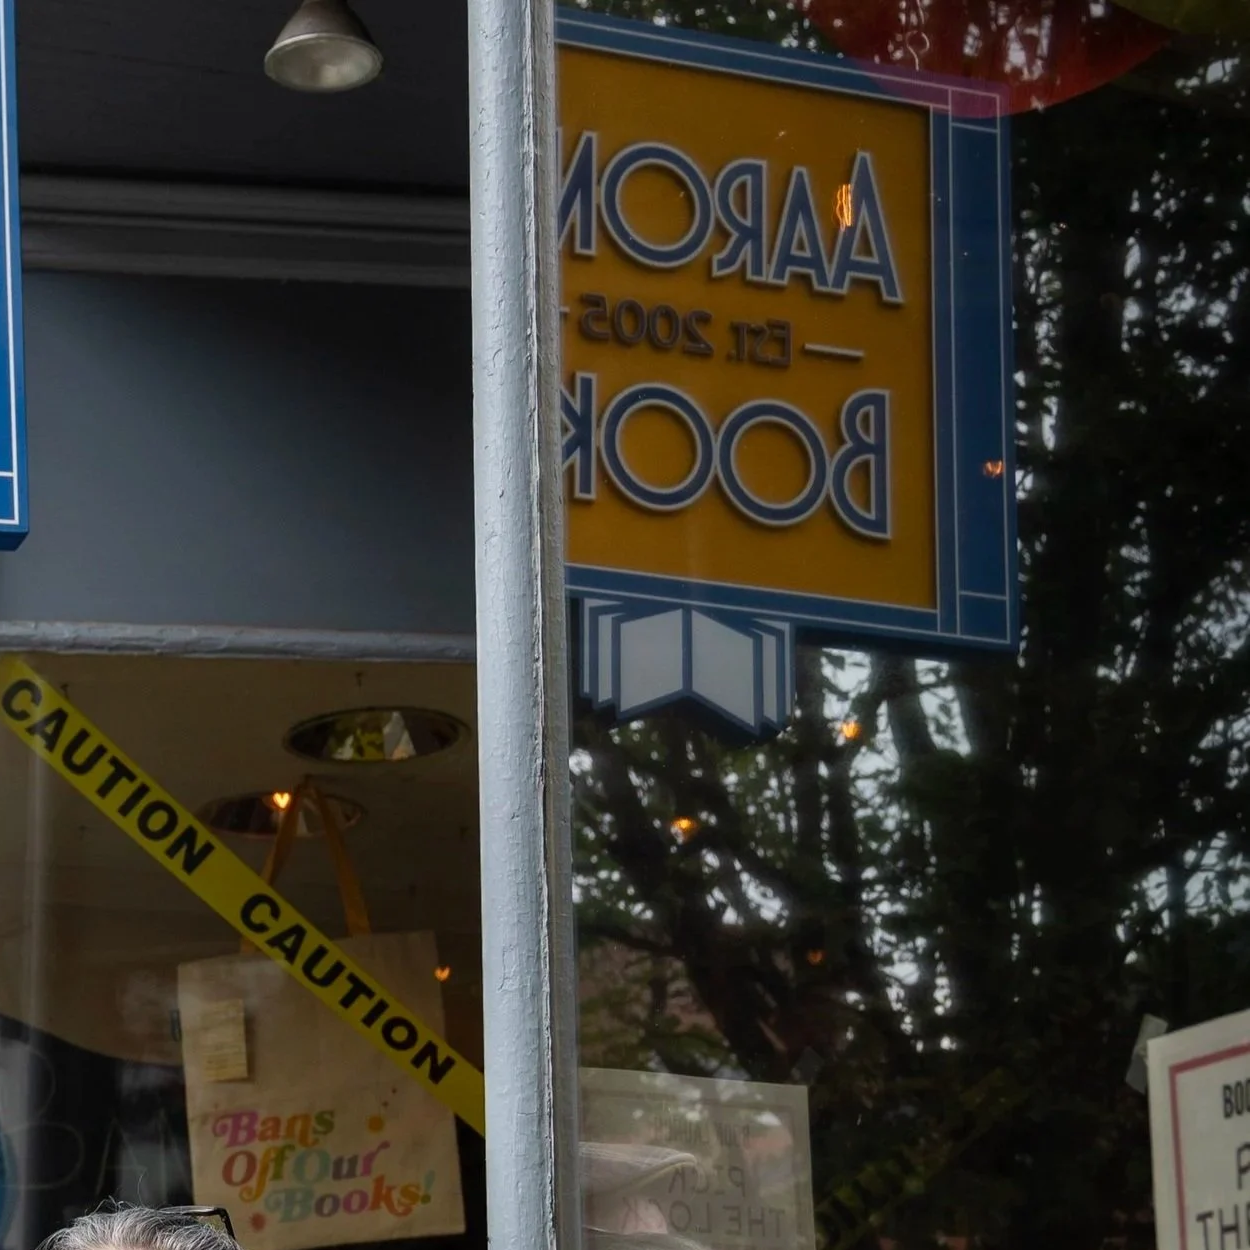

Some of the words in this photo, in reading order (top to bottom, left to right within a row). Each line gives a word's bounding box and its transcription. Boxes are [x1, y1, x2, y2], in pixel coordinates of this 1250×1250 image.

[0, 677, 218, 876] CAUTION
[239, 892, 457, 1086] CAUTION
[212, 1110, 335, 1148] Bans
[222, 1144, 296, 1203] Off
[292, 1140, 391, 1186] Our
[264, 1170, 436, 1224] Books!
